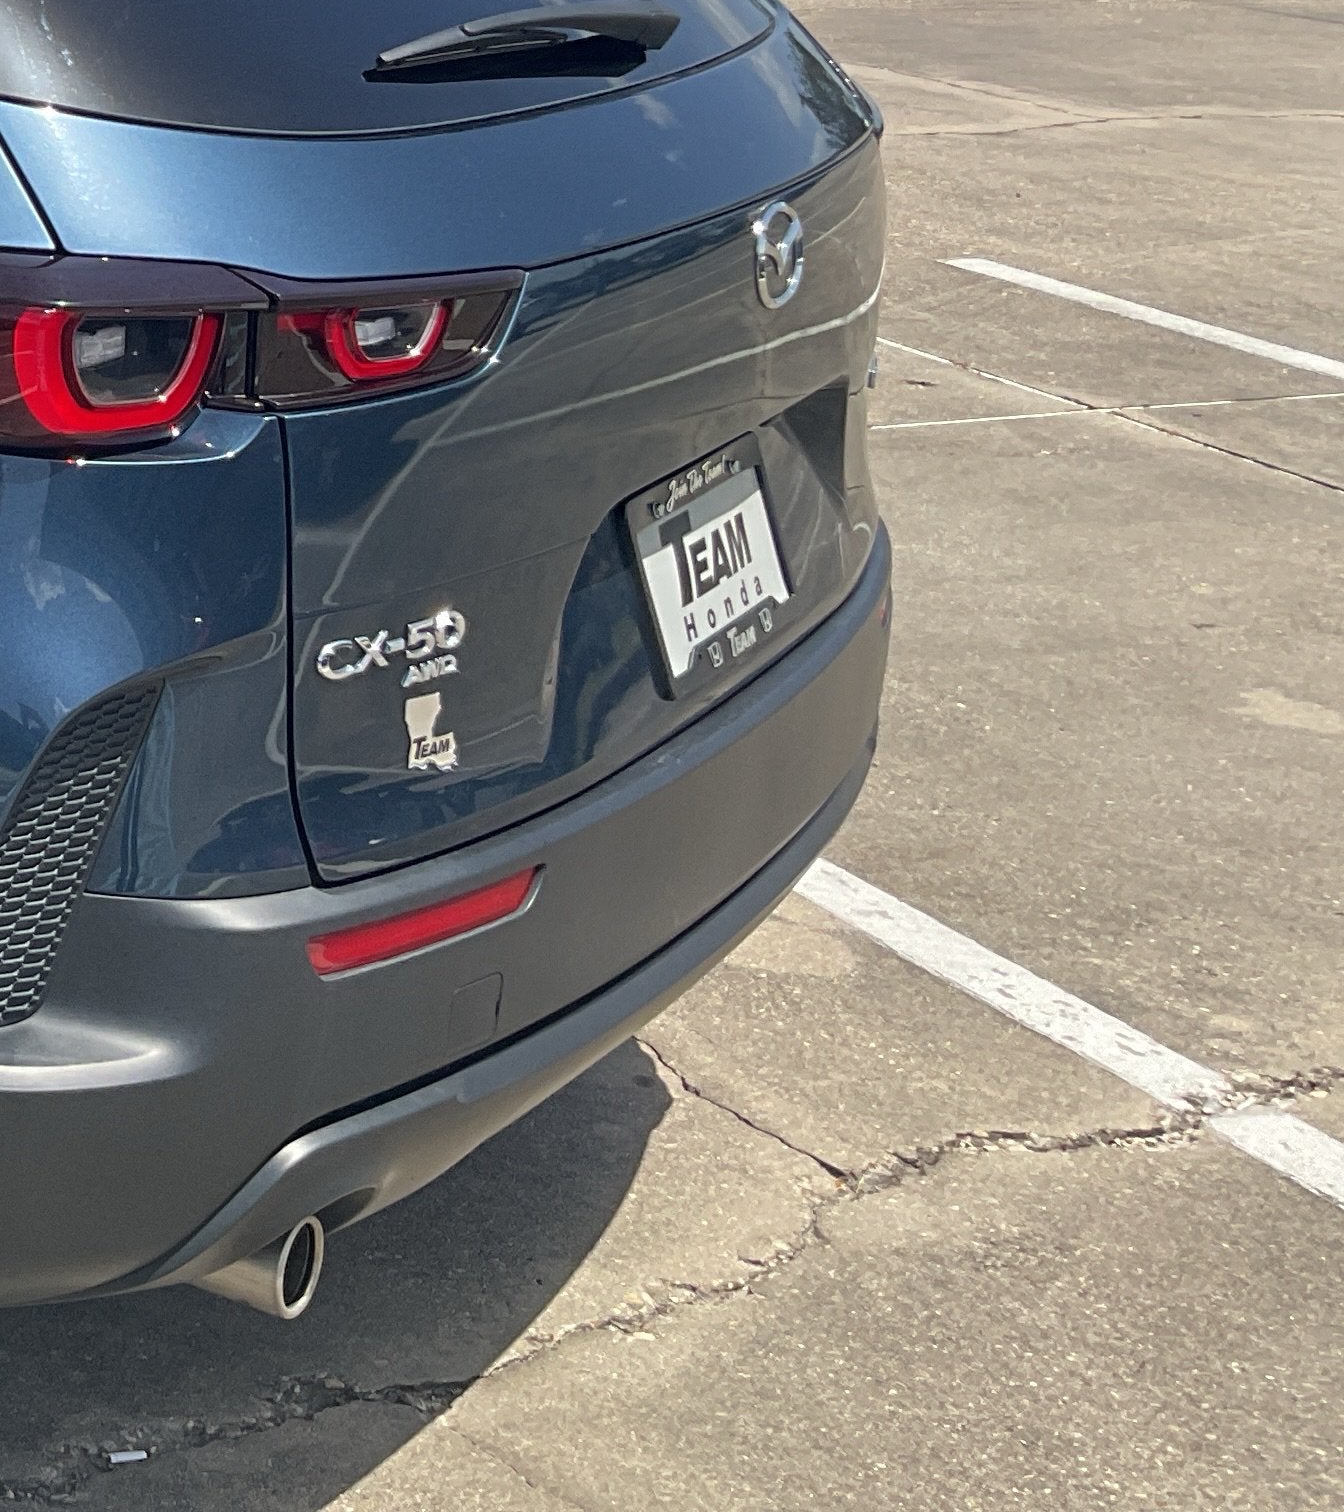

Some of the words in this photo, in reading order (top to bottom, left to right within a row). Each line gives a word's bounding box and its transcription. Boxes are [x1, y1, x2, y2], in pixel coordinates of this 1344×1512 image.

[666, 479, 689, 513] Join
[687, 468, 704, 495] The
[658, 509, 752, 608] TEAM
[683, 575, 764, 642] Honda
[316, 609, 466, 681] CX-50
[400, 653, 460, 688] AWD
[413, 735, 450, 760] TEAM
